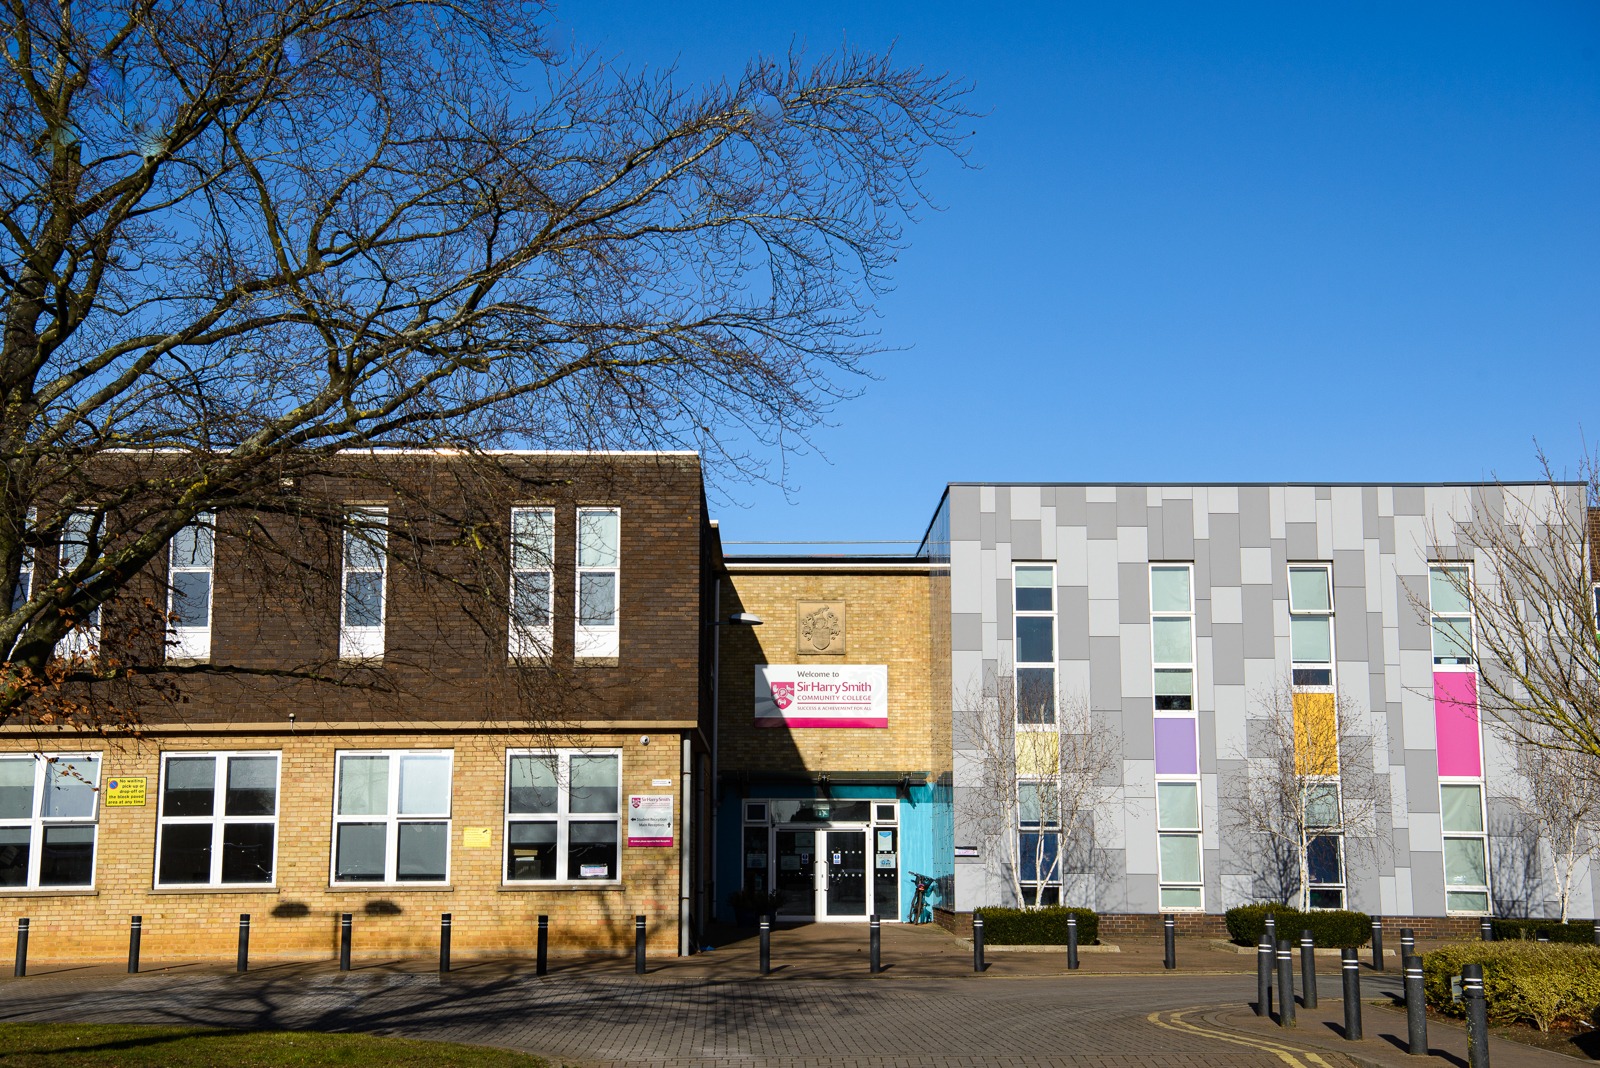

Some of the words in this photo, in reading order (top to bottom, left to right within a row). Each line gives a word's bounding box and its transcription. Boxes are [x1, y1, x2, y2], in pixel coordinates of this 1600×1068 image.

[797, 682, 810, 692] Sir
[812, 682, 841, 694] Harry
[842, 682, 871, 692] Smith
